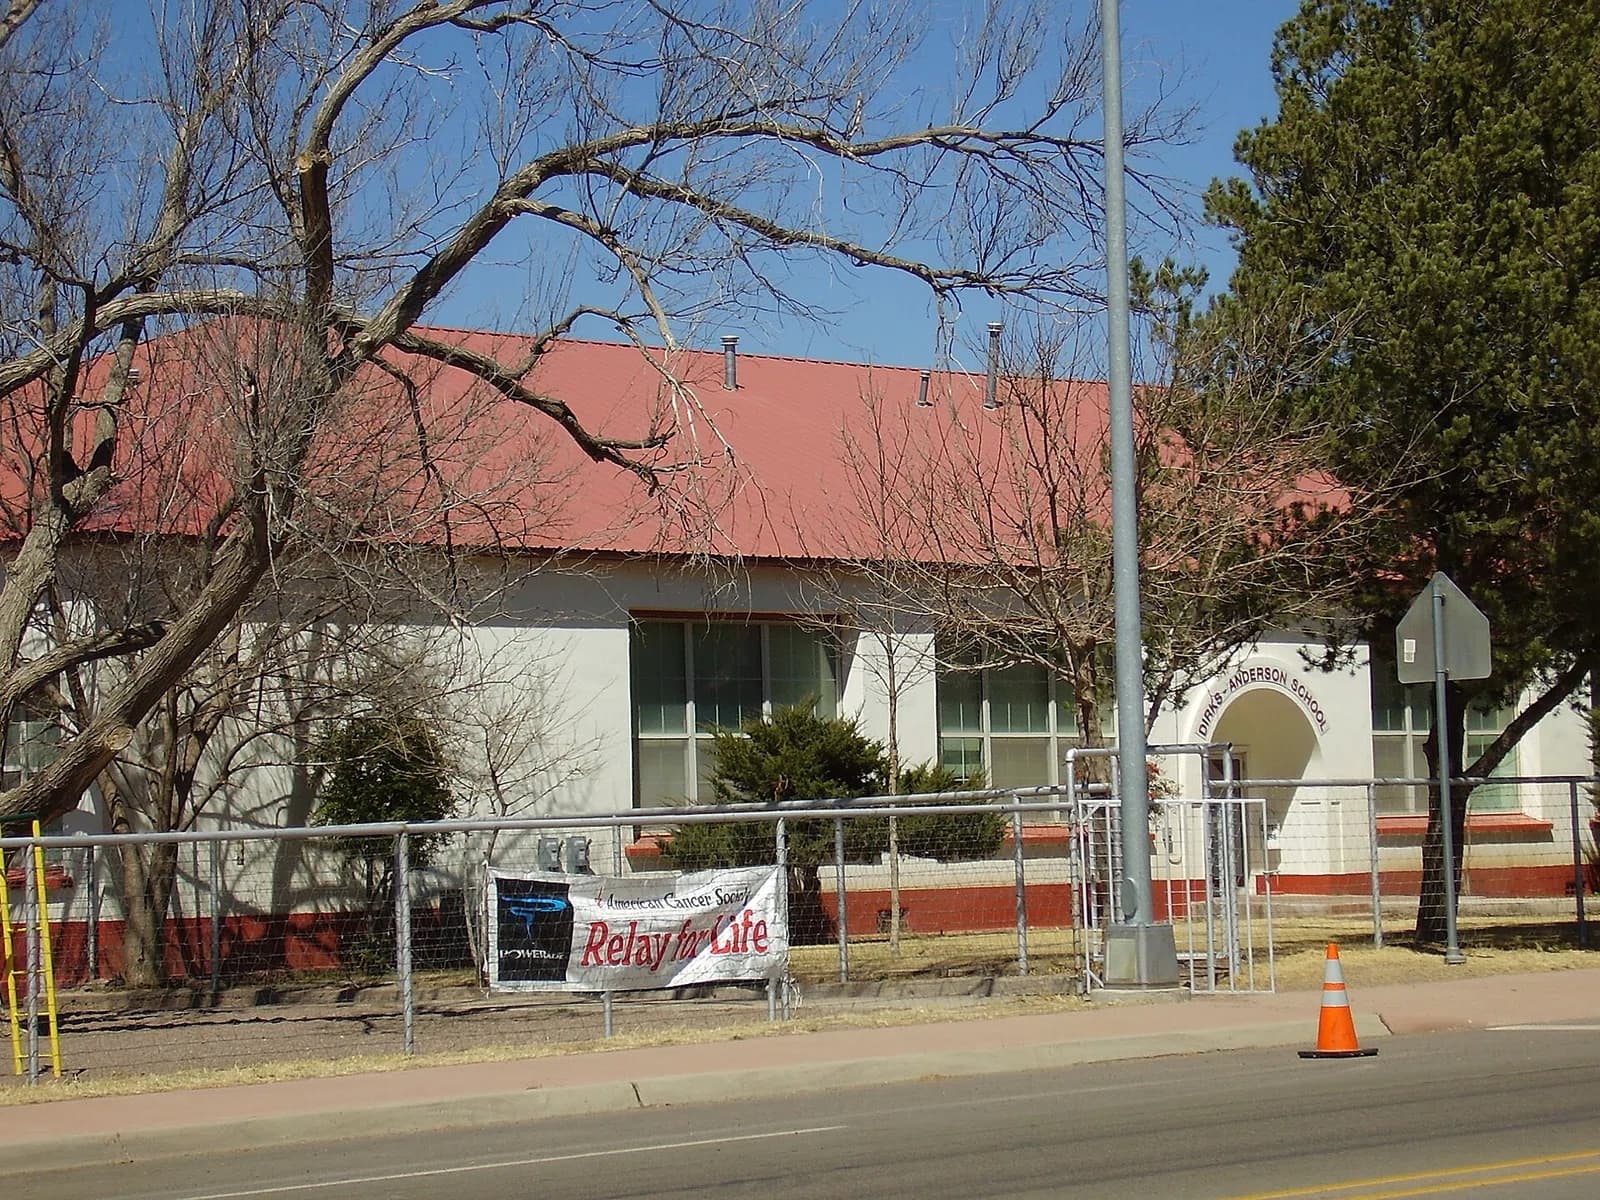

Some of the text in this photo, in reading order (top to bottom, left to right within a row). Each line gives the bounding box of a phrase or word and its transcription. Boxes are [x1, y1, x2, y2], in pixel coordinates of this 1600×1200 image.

[1290, 678, 1329, 732] SCHOOL
[607, 893, 664, 910] American
[664, 892, 712, 908] Cancer
[580, 908, 769, 971] Relay for Life
